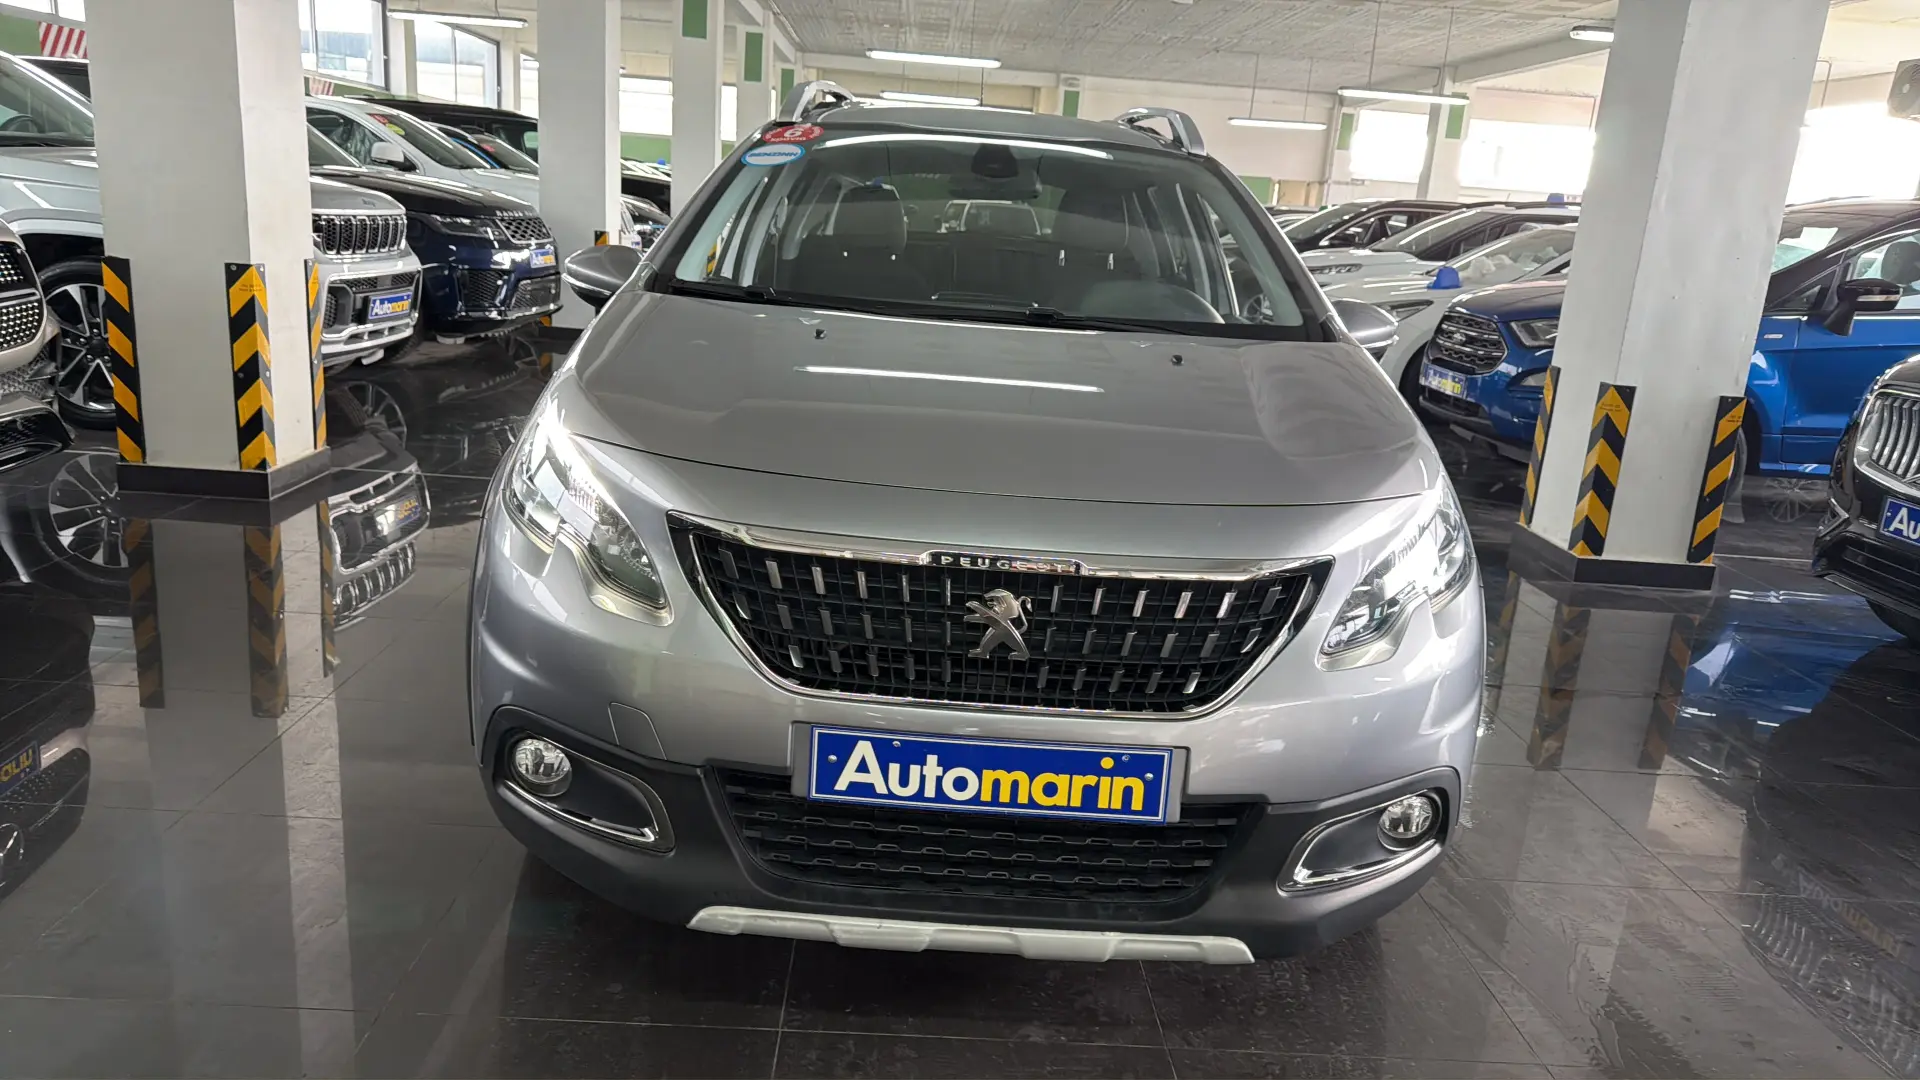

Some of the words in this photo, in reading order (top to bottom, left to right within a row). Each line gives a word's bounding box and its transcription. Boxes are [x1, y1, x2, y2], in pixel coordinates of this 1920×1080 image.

[784, 128, 804, 138] 6
[940, 555, 1066, 574] PEUGEOT
[833, 739, 1145, 812] Automarin
